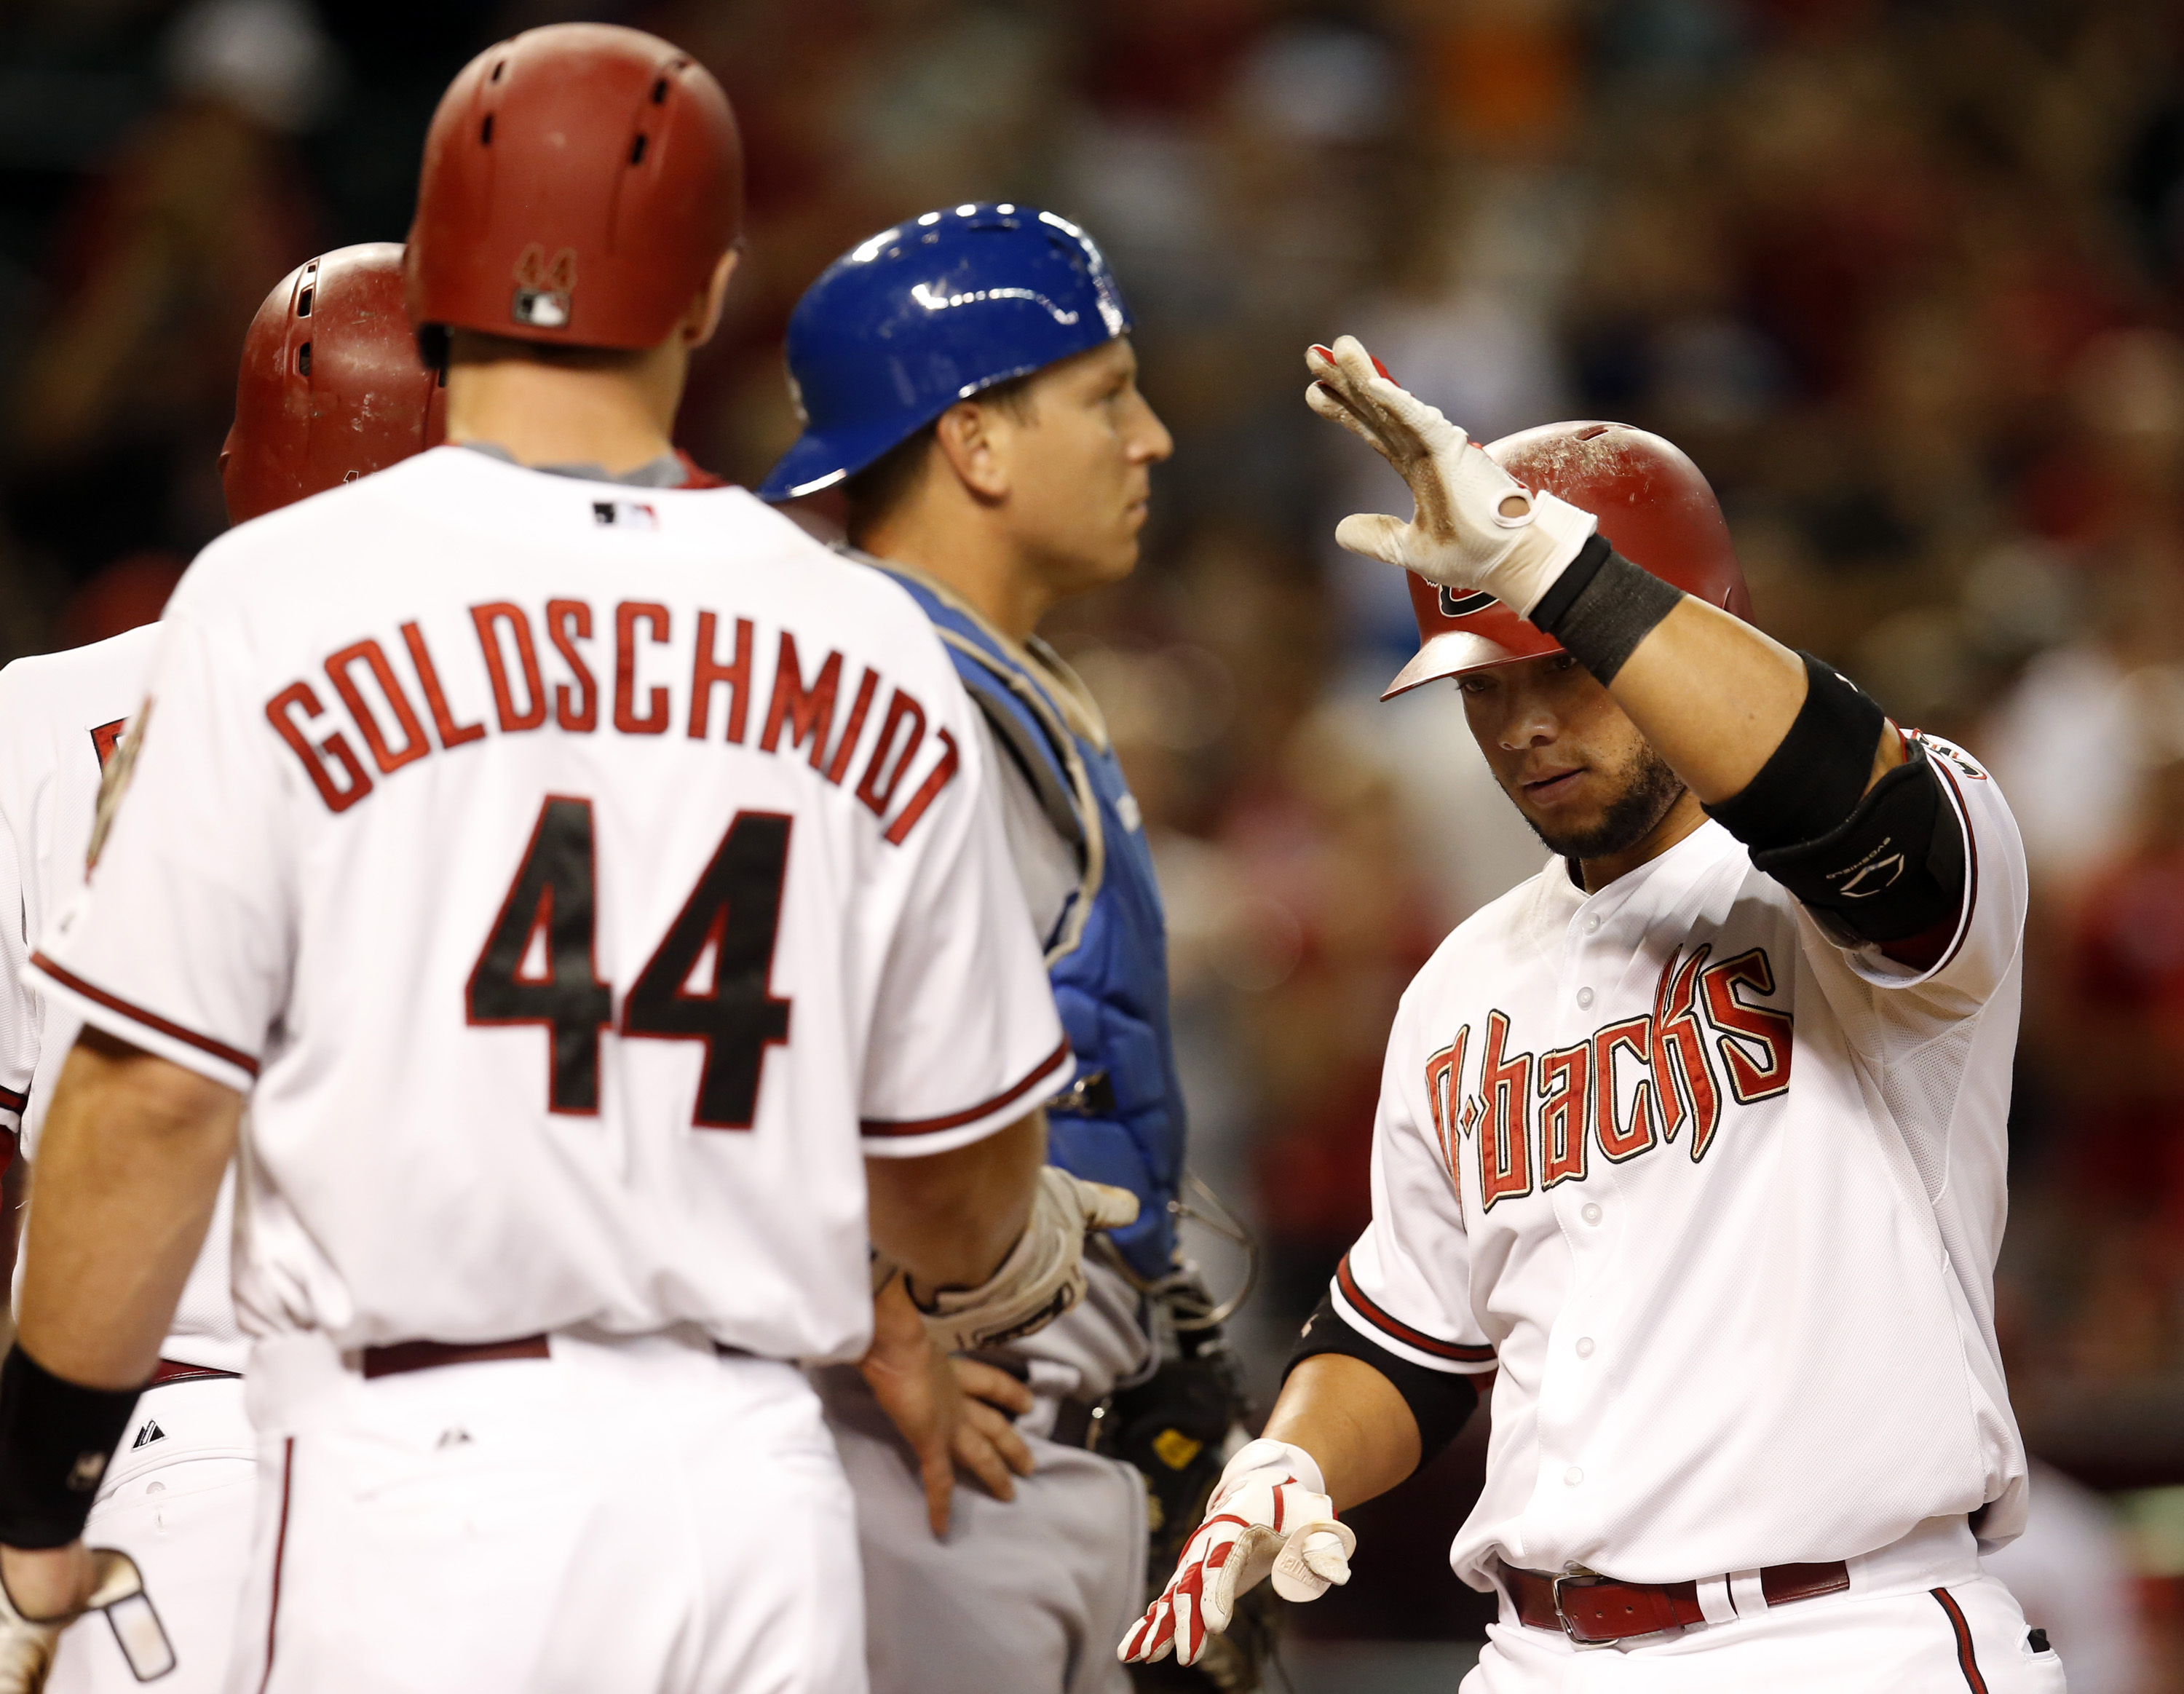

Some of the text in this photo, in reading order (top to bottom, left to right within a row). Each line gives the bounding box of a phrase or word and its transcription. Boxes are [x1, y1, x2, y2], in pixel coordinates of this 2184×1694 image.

[512, 242, 578, 293] 44
[265, 598, 960, 847] GOLDSCHMIDT
[464, 793, 794, 1131] 44
